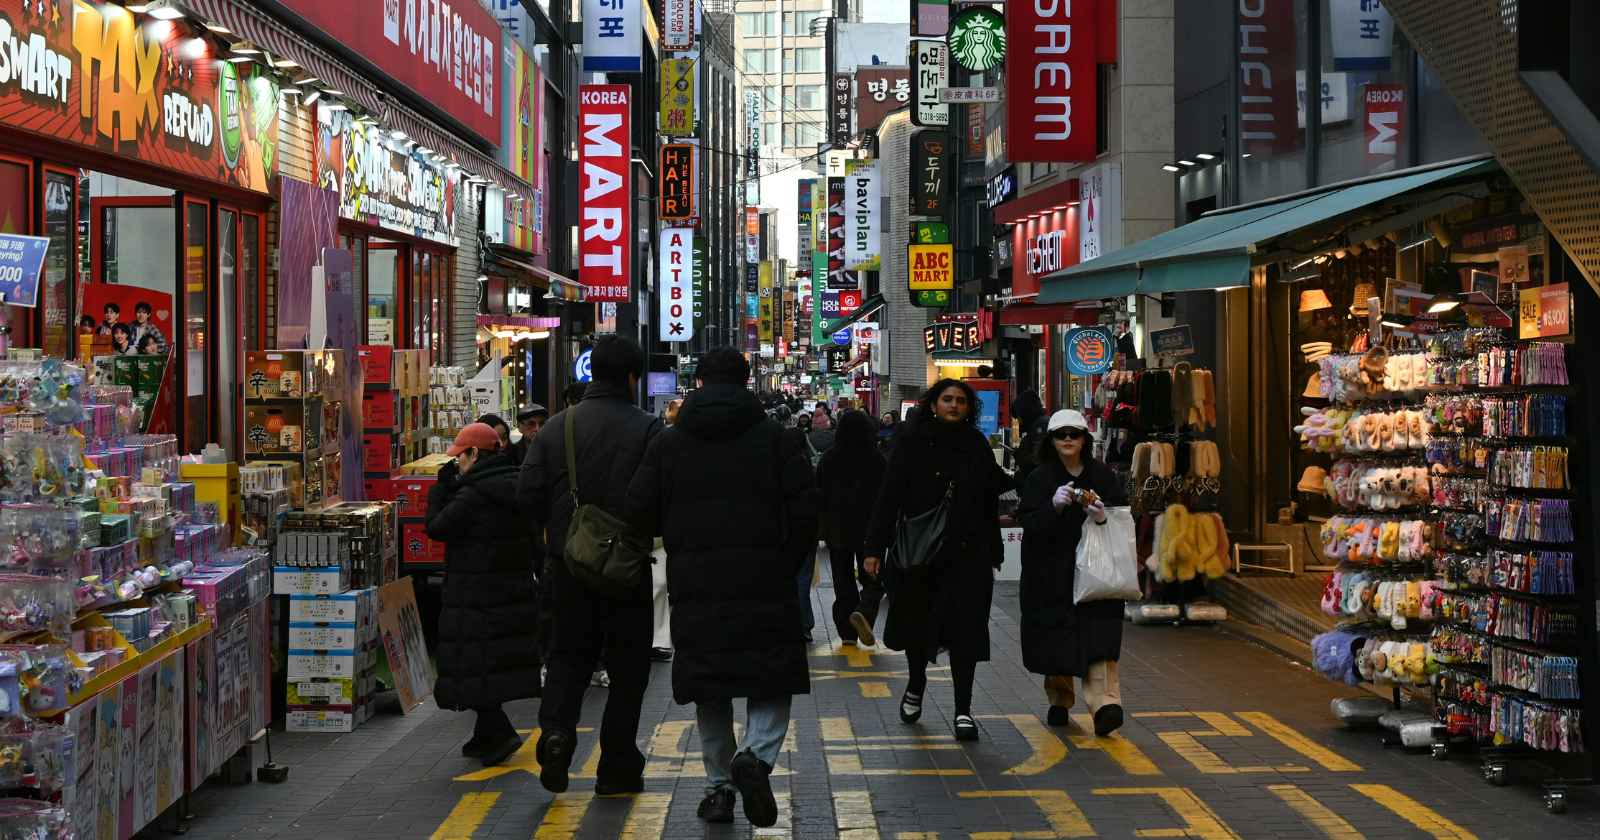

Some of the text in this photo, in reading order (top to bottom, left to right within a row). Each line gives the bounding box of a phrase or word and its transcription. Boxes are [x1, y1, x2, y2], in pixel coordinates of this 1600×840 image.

[919, 13, 947, 22] KIRIKO
[0, 0, 213, 147] SMART TAX REFUND
[581, 91, 627, 105] KOREA
[954, 90, 995, 99] 皮膚科 6F
[752, 93, 760, 123] HALAL
[353, 132, 390, 194] SMART
[666, 150, 678, 214] HAIR
[583, 113, 623, 276] MART
[926, 199, 938, 209] 2F
[675, 219, 698, 227] 3F 4F
[855, 178, 870, 251] baviplan
[913, 252, 949, 270] ABC
[669, 233, 684, 335] ARTBOX
[692, 249, 702, 318] ANOTHER
[913, 270, 949, 282] MART
[1476, 285, 1494, 296] SALE
[1522, 304, 1536, 320] SALE
[925, 326, 979, 349] EVER
[1157, 335, 1185, 346] SALE
[248, 369, 269, 397] 辛
[248, 424, 269, 452] 辛
[396, 492, 411, 513] 辛
[408, 537, 424, 559] 辛
